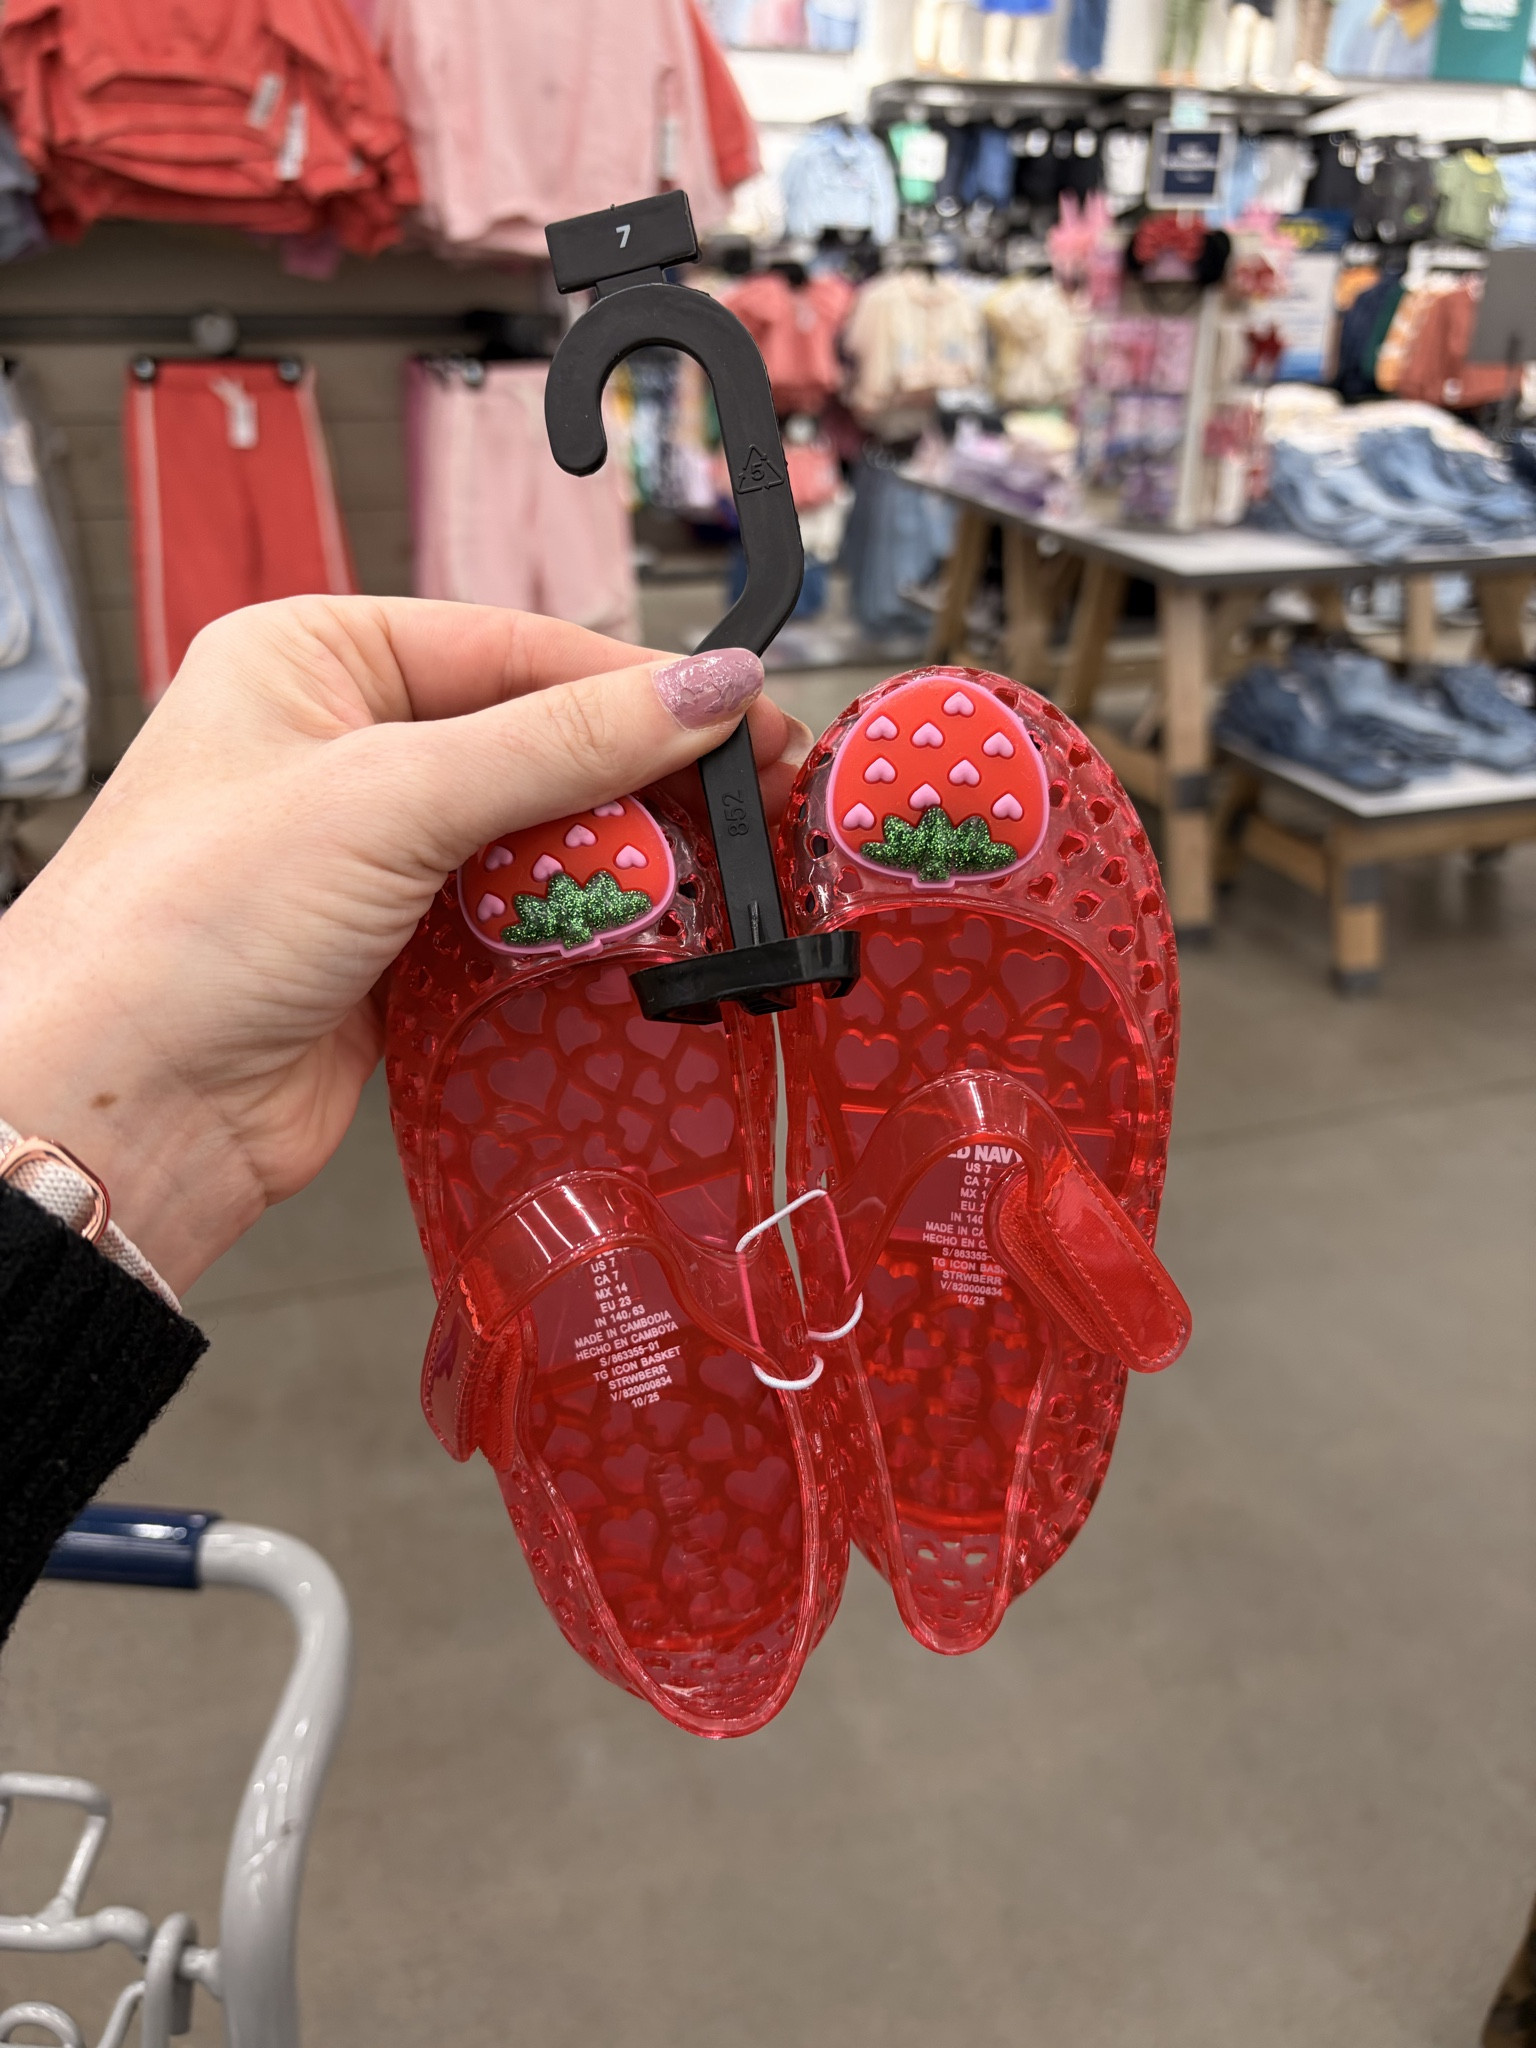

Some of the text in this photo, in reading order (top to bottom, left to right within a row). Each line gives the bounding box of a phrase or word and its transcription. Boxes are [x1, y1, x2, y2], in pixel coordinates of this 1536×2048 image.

[616, 224, 631, 249] 7
[750, 462, 765, 481] 5
[721, 789, 749, 837] 852
[965, 1162, 992, 1175] US 7
[963, 1175, 991, 1187] CA 7
[960, 1187, 977, 1199] MX
[960, 1200, 976, 1212] EU
[950, 1211, 984, 1225] IN 140
[925, 1221, 954, 1234] MADE
[957, 1225, 968, 1236] IN
[922, 1232, 958, 1246] HECHO
[961, 1237, 975, 1249] EN
[942, 1247, 993, 1261] S/863355-
[590, 1257, 615, 1273] US 7
[931, 1256, 946, 1267] TG
[949, 1259, 976, 1271] ICON
[594, 1270, 619, 1286] CA 7
[942, 1269, 1002, 1285] STRWBERR
[594, 1282, 628, 1300] MX 14
[600, 1295, 632, 1313] EU 23
[957, 1294, 985, 1306] 10/25
[574, 1310, 672, 1348] MADE IN CAMBODIA
[594, 1317, 607, 1328] IN
[575, 1321, 679, 1361] HECHO EN CAMBOYA
[599, 1340, 660, 1367] S/863355-01
[592, 1345, 680, 1381] TG ICON BASKET
[608, 1364, 668, 1390] STRWBERR
[610, 1375, 672, 1402] V/820000834
[631, 1391, 660, 1408] 10/25
